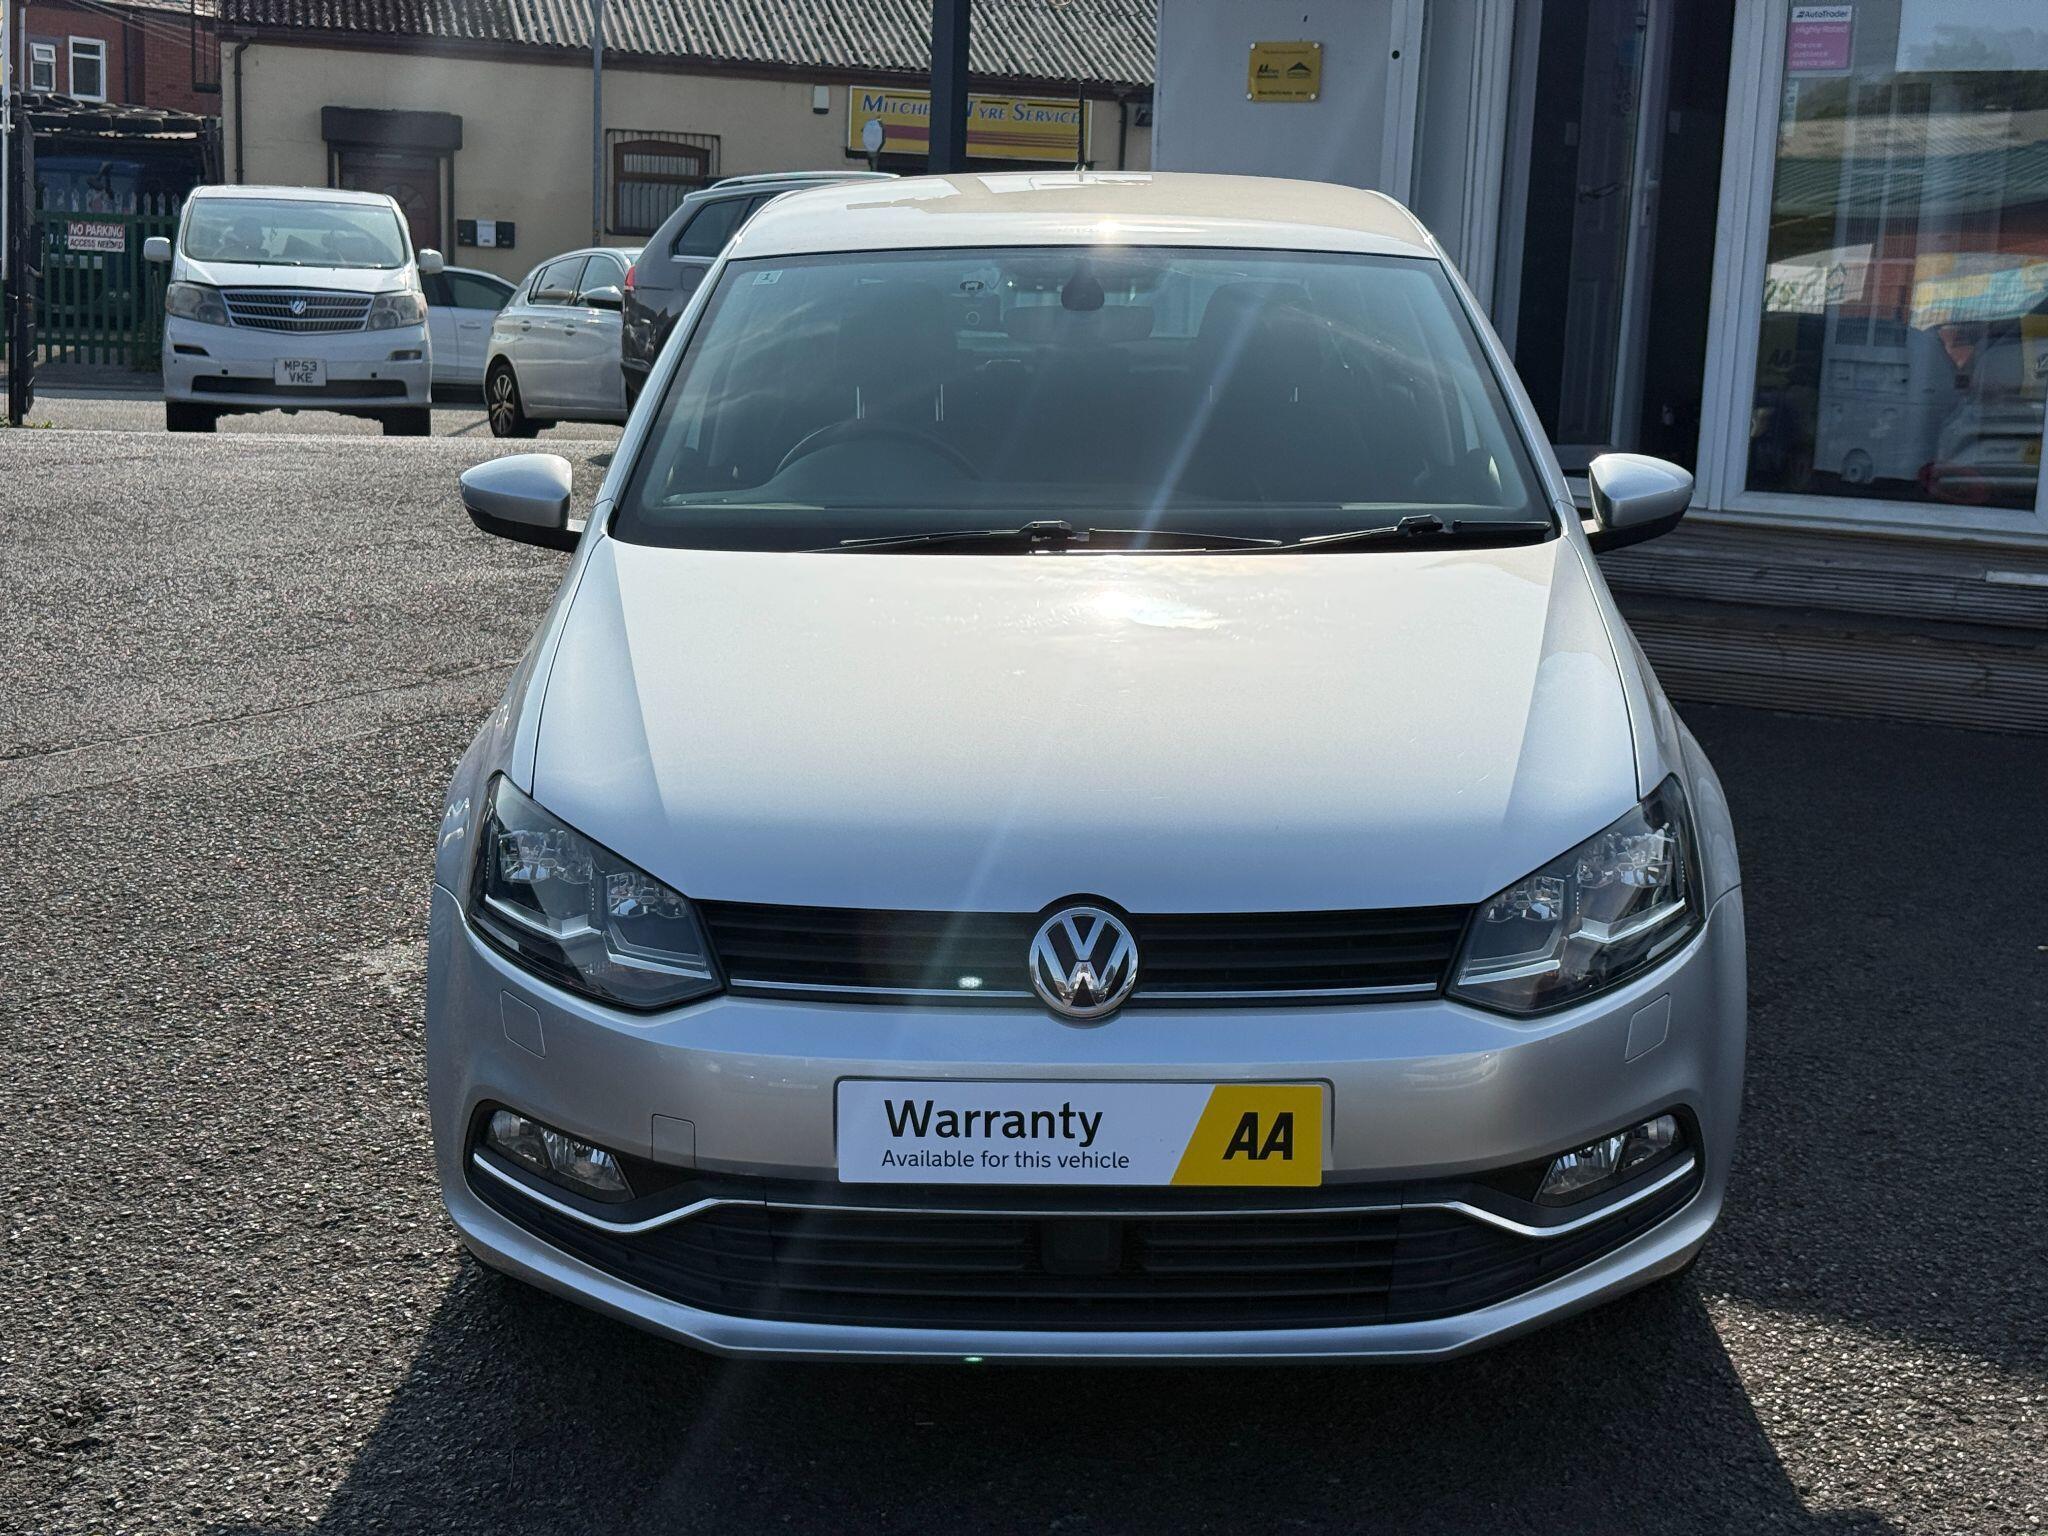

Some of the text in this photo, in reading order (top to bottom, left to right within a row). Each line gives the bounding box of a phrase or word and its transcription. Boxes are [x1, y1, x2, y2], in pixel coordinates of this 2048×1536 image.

[70, 223, 123, 238] NO PARKING
[70, 238, 96, 248] ACCESS
[284, 360, 318, 371] MP53
[289, 371, 314, 384] VKE
[884, 1099, 1104, 1148] Warranty
[1222, 1111, 1295, 1161] AA
[881, 1149, 1130, 1169] Available for this vehicle
